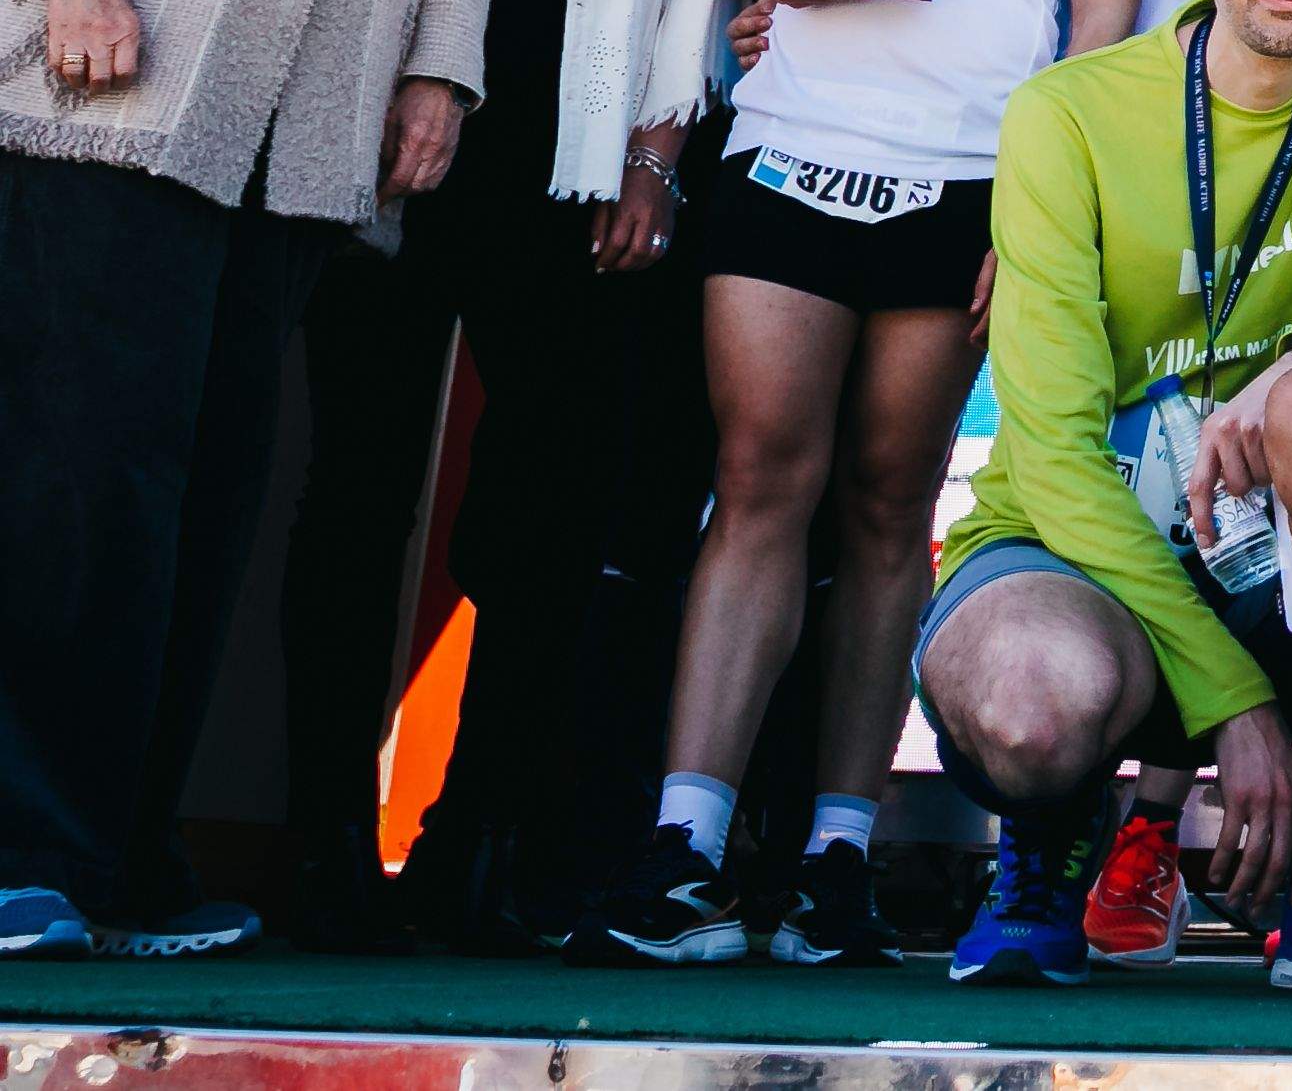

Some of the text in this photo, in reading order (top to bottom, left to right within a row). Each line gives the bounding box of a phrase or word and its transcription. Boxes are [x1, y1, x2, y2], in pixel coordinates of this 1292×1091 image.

[1196, 97, 1204, 133] METLIFE
[1198, 139, 1206, 176] MADRID
[796, 160, 900, 215] 3206
[1200, 180, 1208, 211] ACTIVA
[1145, 338, 1195, 377] VIII
